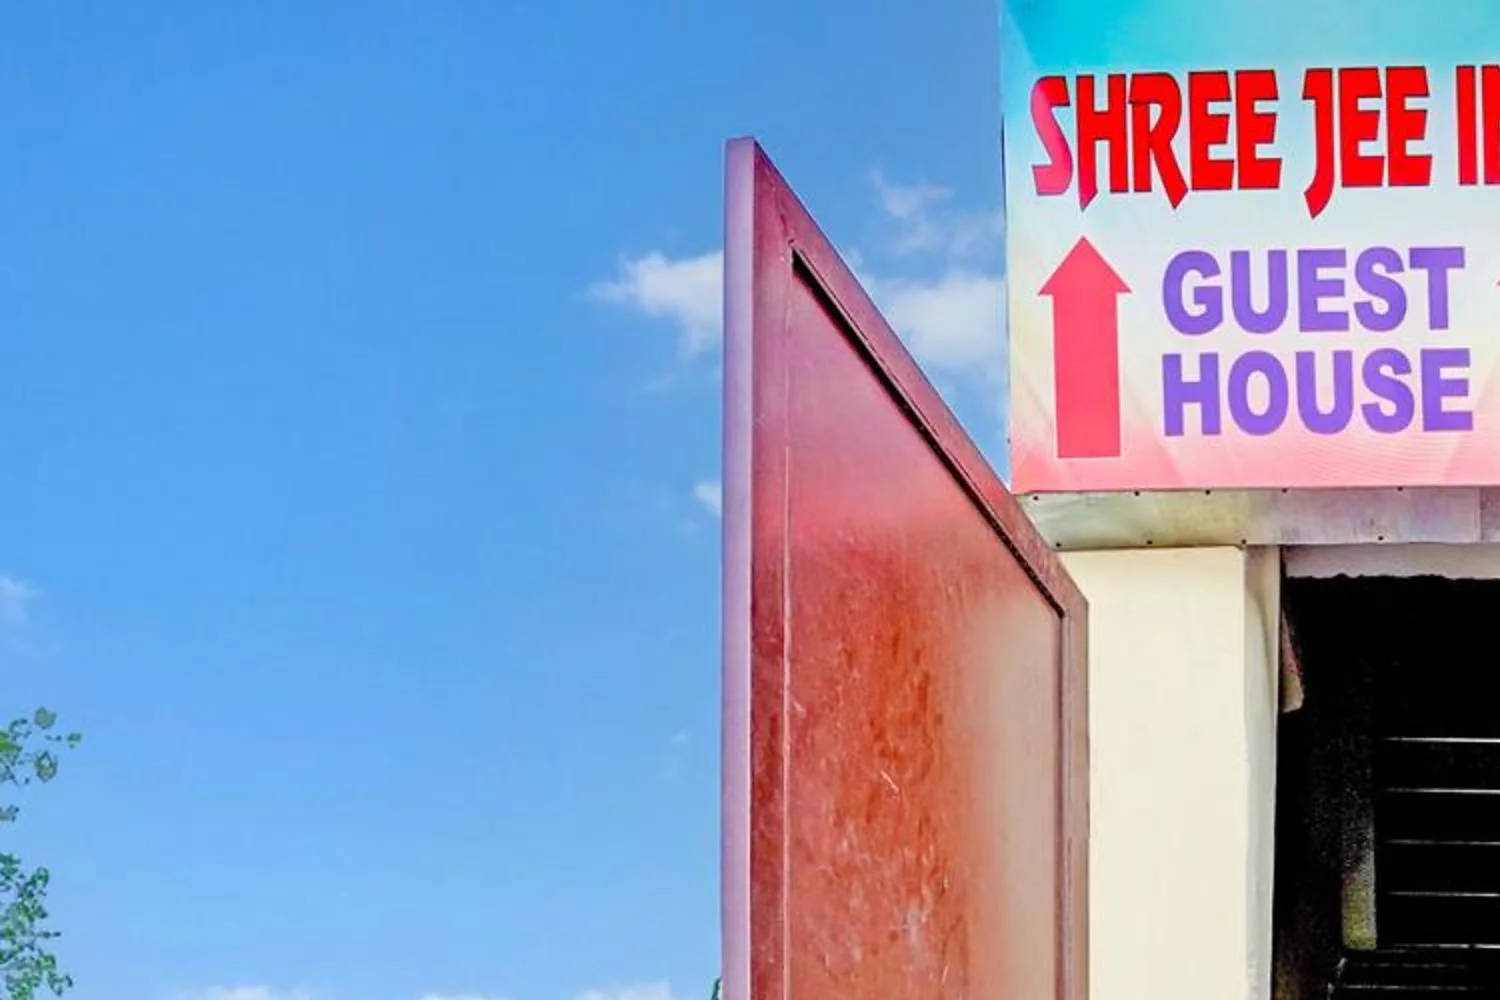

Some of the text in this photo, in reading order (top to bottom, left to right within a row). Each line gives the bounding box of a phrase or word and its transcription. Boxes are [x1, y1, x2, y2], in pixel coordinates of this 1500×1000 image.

[1030, 70, 1282, 210] SHREE
[1303, 67, 1433, 219] JEE
[1162, 247, 1465, 335] GUEST
[1162, 348, 1473, 436] HOUSE
